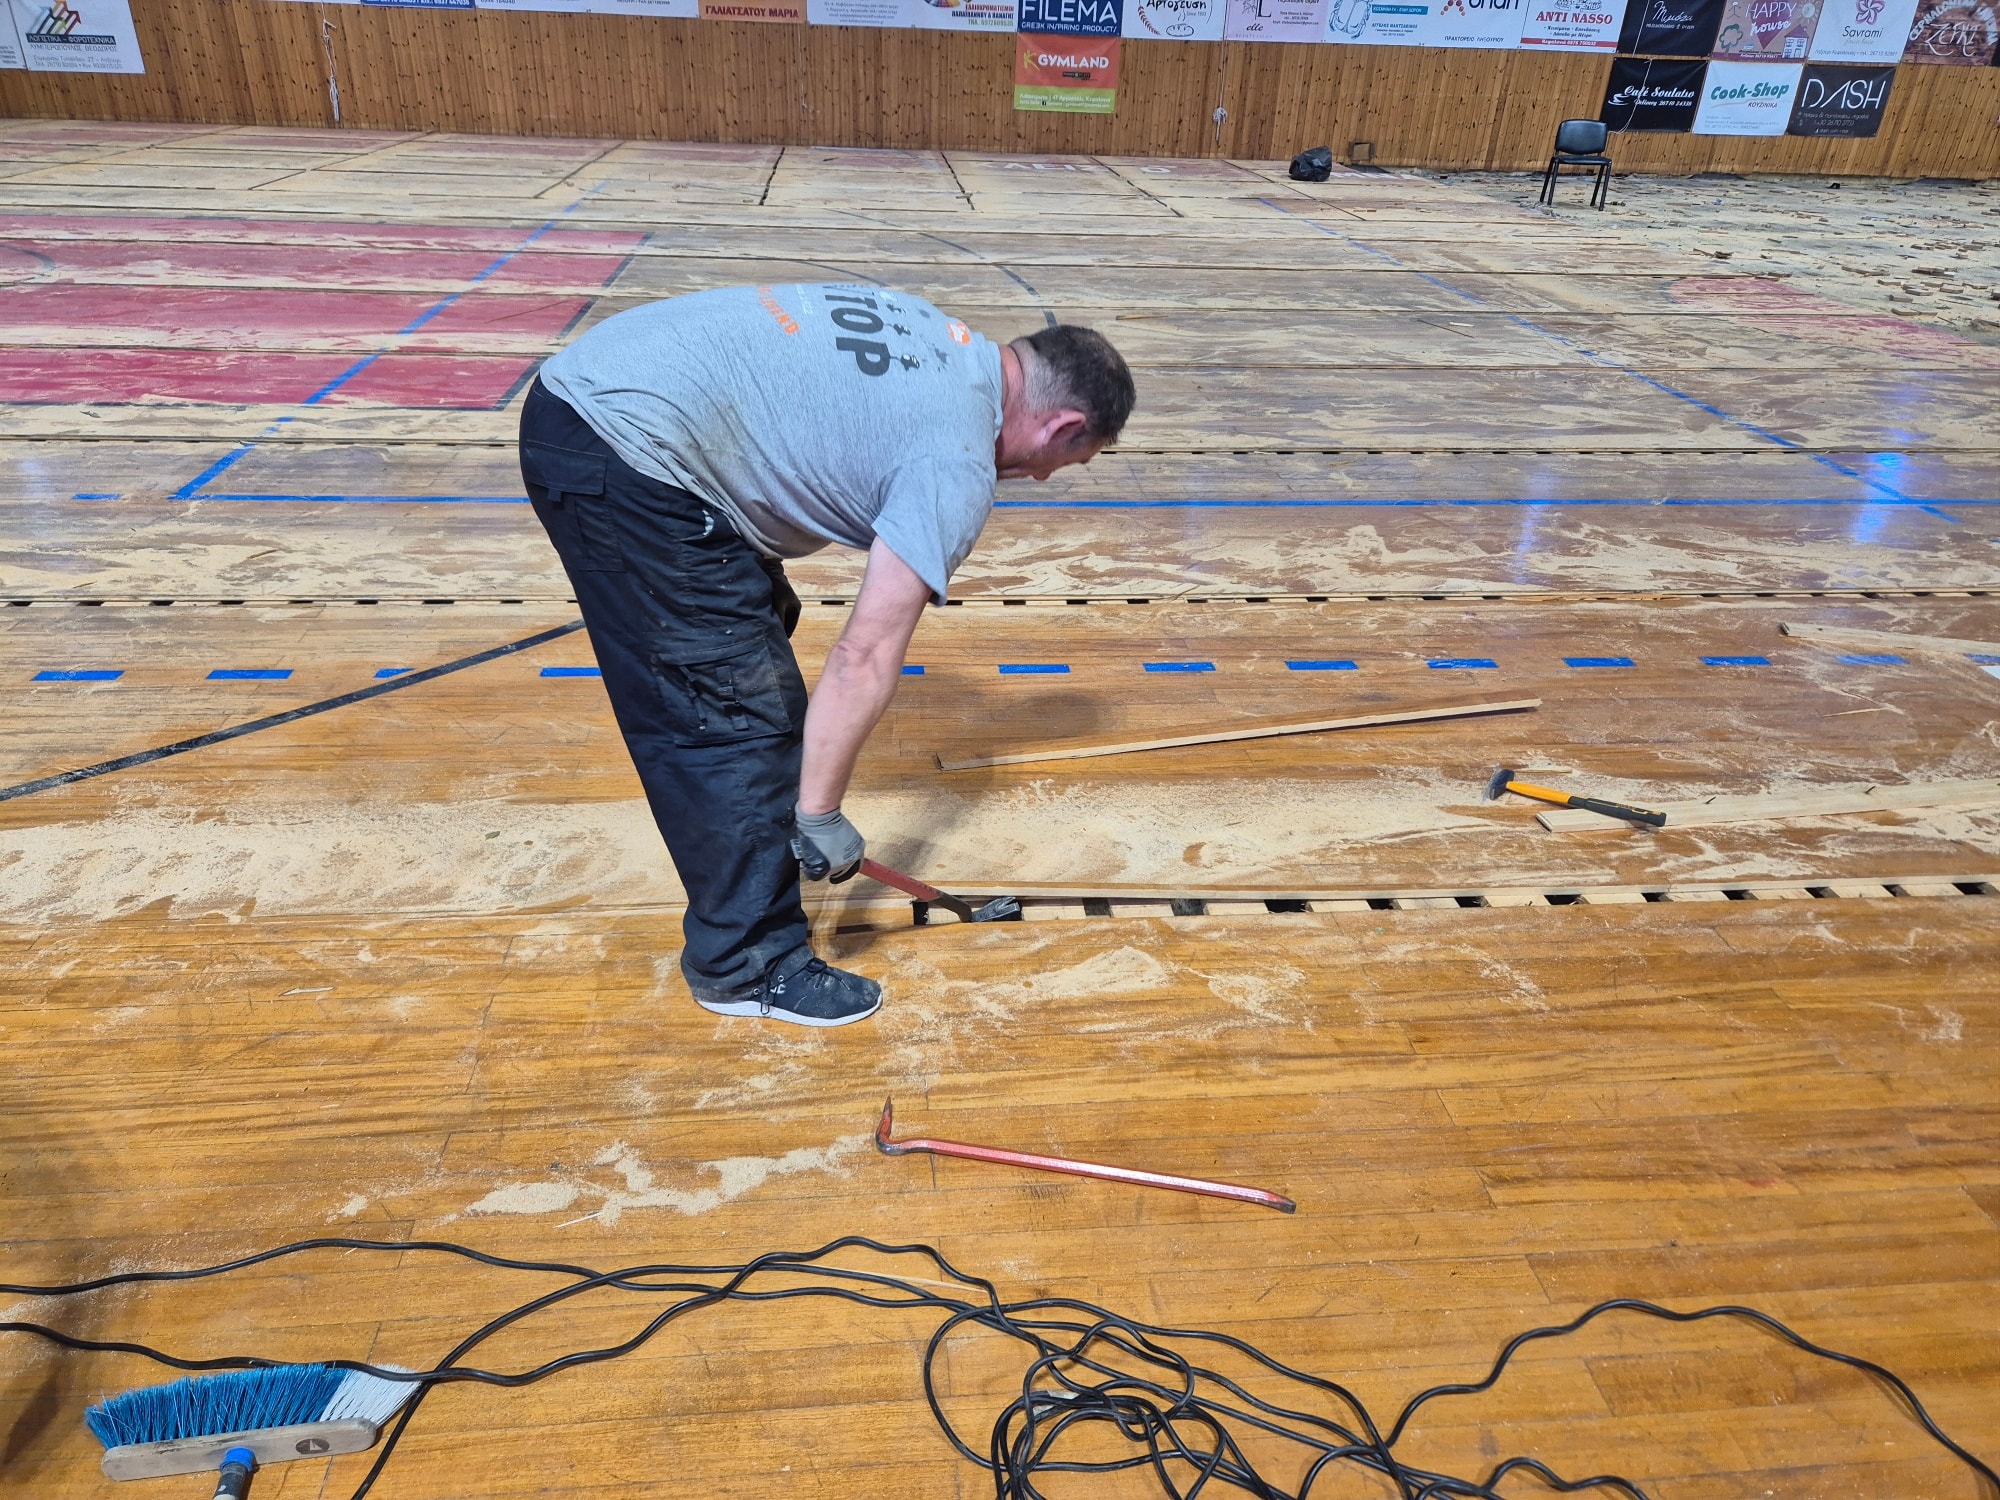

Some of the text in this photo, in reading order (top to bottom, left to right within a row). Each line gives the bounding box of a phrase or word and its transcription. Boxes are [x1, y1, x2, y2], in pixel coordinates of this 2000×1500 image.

[769, 8, 799, 18] ΜΑΡΙΑ
[1021, 0, 1118, 24] FILEMA
[1536, 11, 1613, 25] ANTI NASSO
[1745, 1, 1797, 19] HAPPY
[1750, 20, 1792, 36] house
[1842, 25, 1884, 38] Savrami
[1037, 54, 1110, 69] GYMLAND
[1711, 81, 1789, 100] Cook-Shop
[1801, 78, 1887, 109] DASH
[823, 285, 891, 376] TOP
